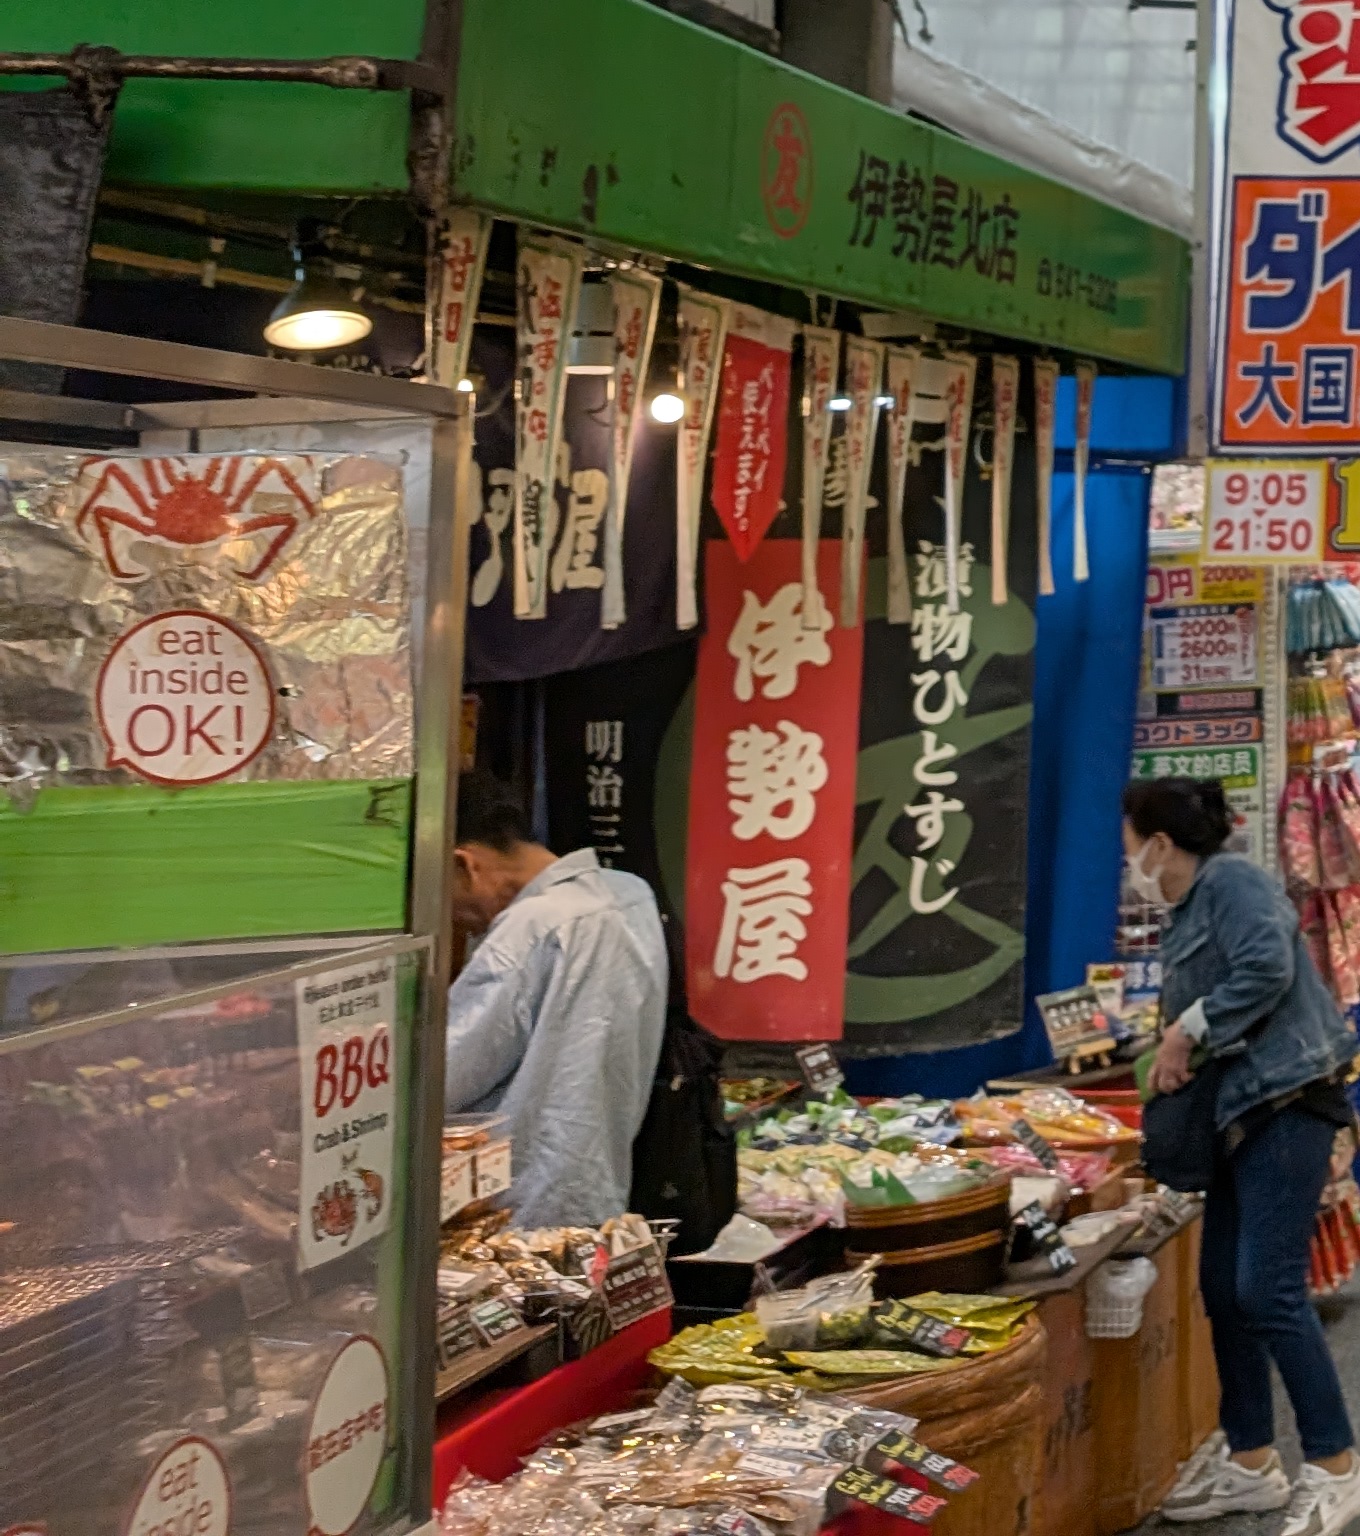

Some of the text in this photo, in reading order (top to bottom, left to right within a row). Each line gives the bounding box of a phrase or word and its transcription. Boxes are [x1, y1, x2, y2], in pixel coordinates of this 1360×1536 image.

[1224, 473, 1307, 506] 9:05
[1213, 519, 1312, 552] 21:50
[158, 626, 222, 656] eat
[129, 662, 249, 695] inside
[127, 704, 245, 757] OK!
[903, 539, 976, 915] 漬物ひとすじ
[585, 721, 625, 868] 明治三
[713, 582, 835, 983] 伊勢屋
[314, 1028, 389, 1117] BBQ
[159, 1450, 200, 1502] eat
